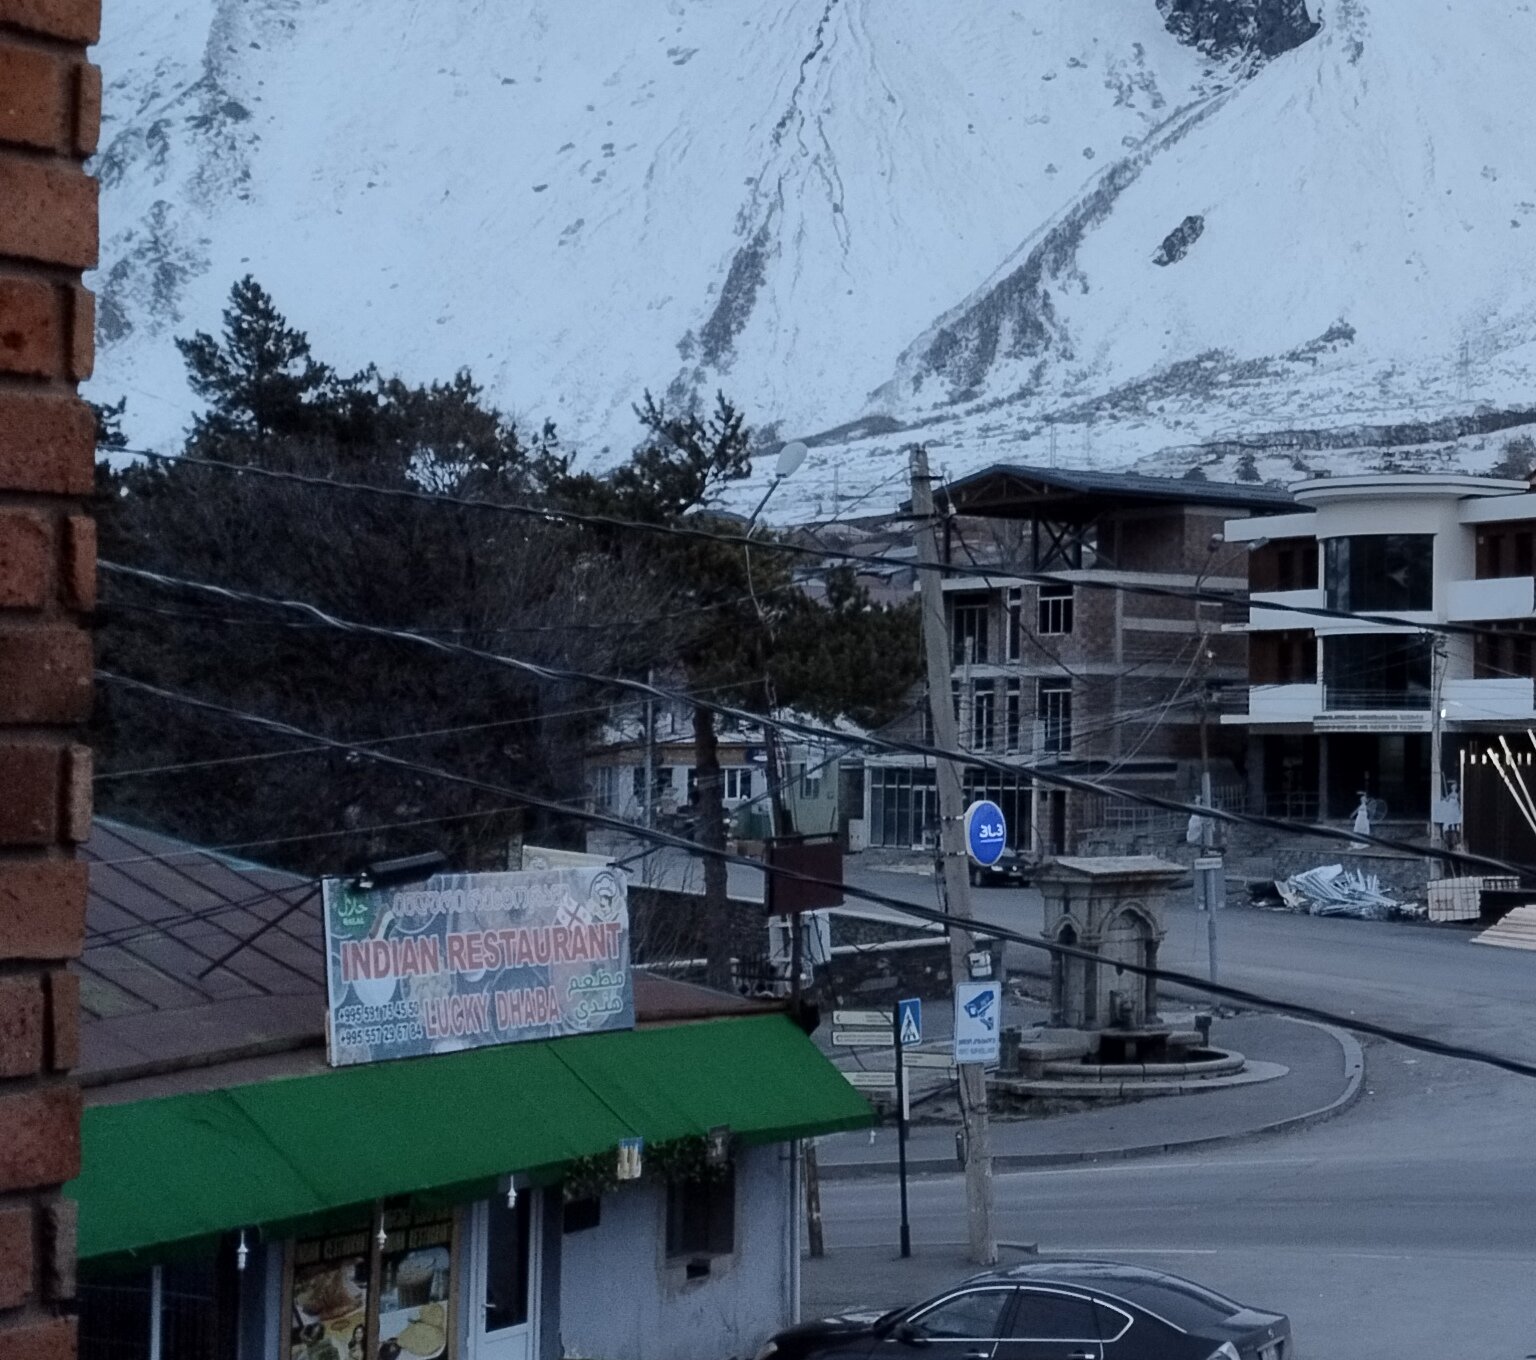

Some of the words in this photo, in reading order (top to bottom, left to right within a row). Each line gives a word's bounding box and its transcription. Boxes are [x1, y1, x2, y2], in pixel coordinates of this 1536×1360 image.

[340, 935, 440, 984] INDIAN
[447, 922, 622, 974] RESTAURANT
[339, 1005, 362, 1022] +995
[395, 1001, 407, 1018] 45
[424, 993, 490, 1039] LUCKY
[495, 985, 562, 1031] DHABA
[340, 1028, 363, 1045] +995
